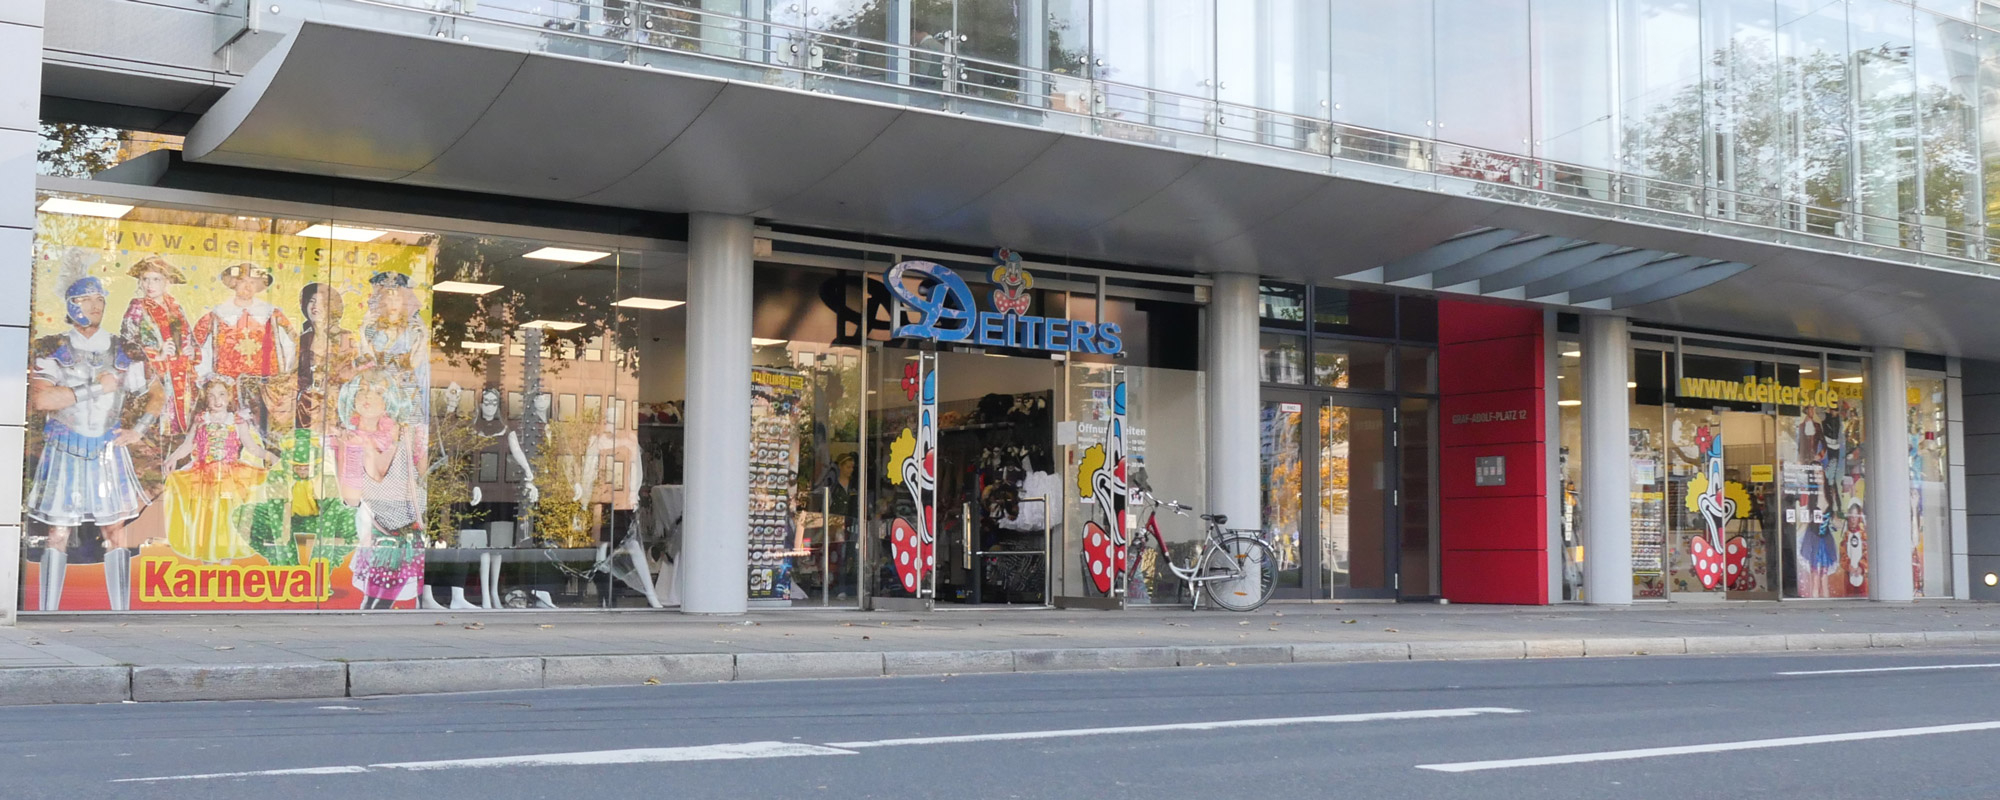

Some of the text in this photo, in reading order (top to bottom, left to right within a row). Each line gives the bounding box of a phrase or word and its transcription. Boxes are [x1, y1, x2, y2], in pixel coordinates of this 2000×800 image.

[106, 231, 381, 267] www.deiters.de
[1682, 375, 1839, 408] www.deiters.de
[1452, 409, 1527, 424] GRAF-ADOLF-PLATZ 12
[145, 560, 325, 598] Karneval
